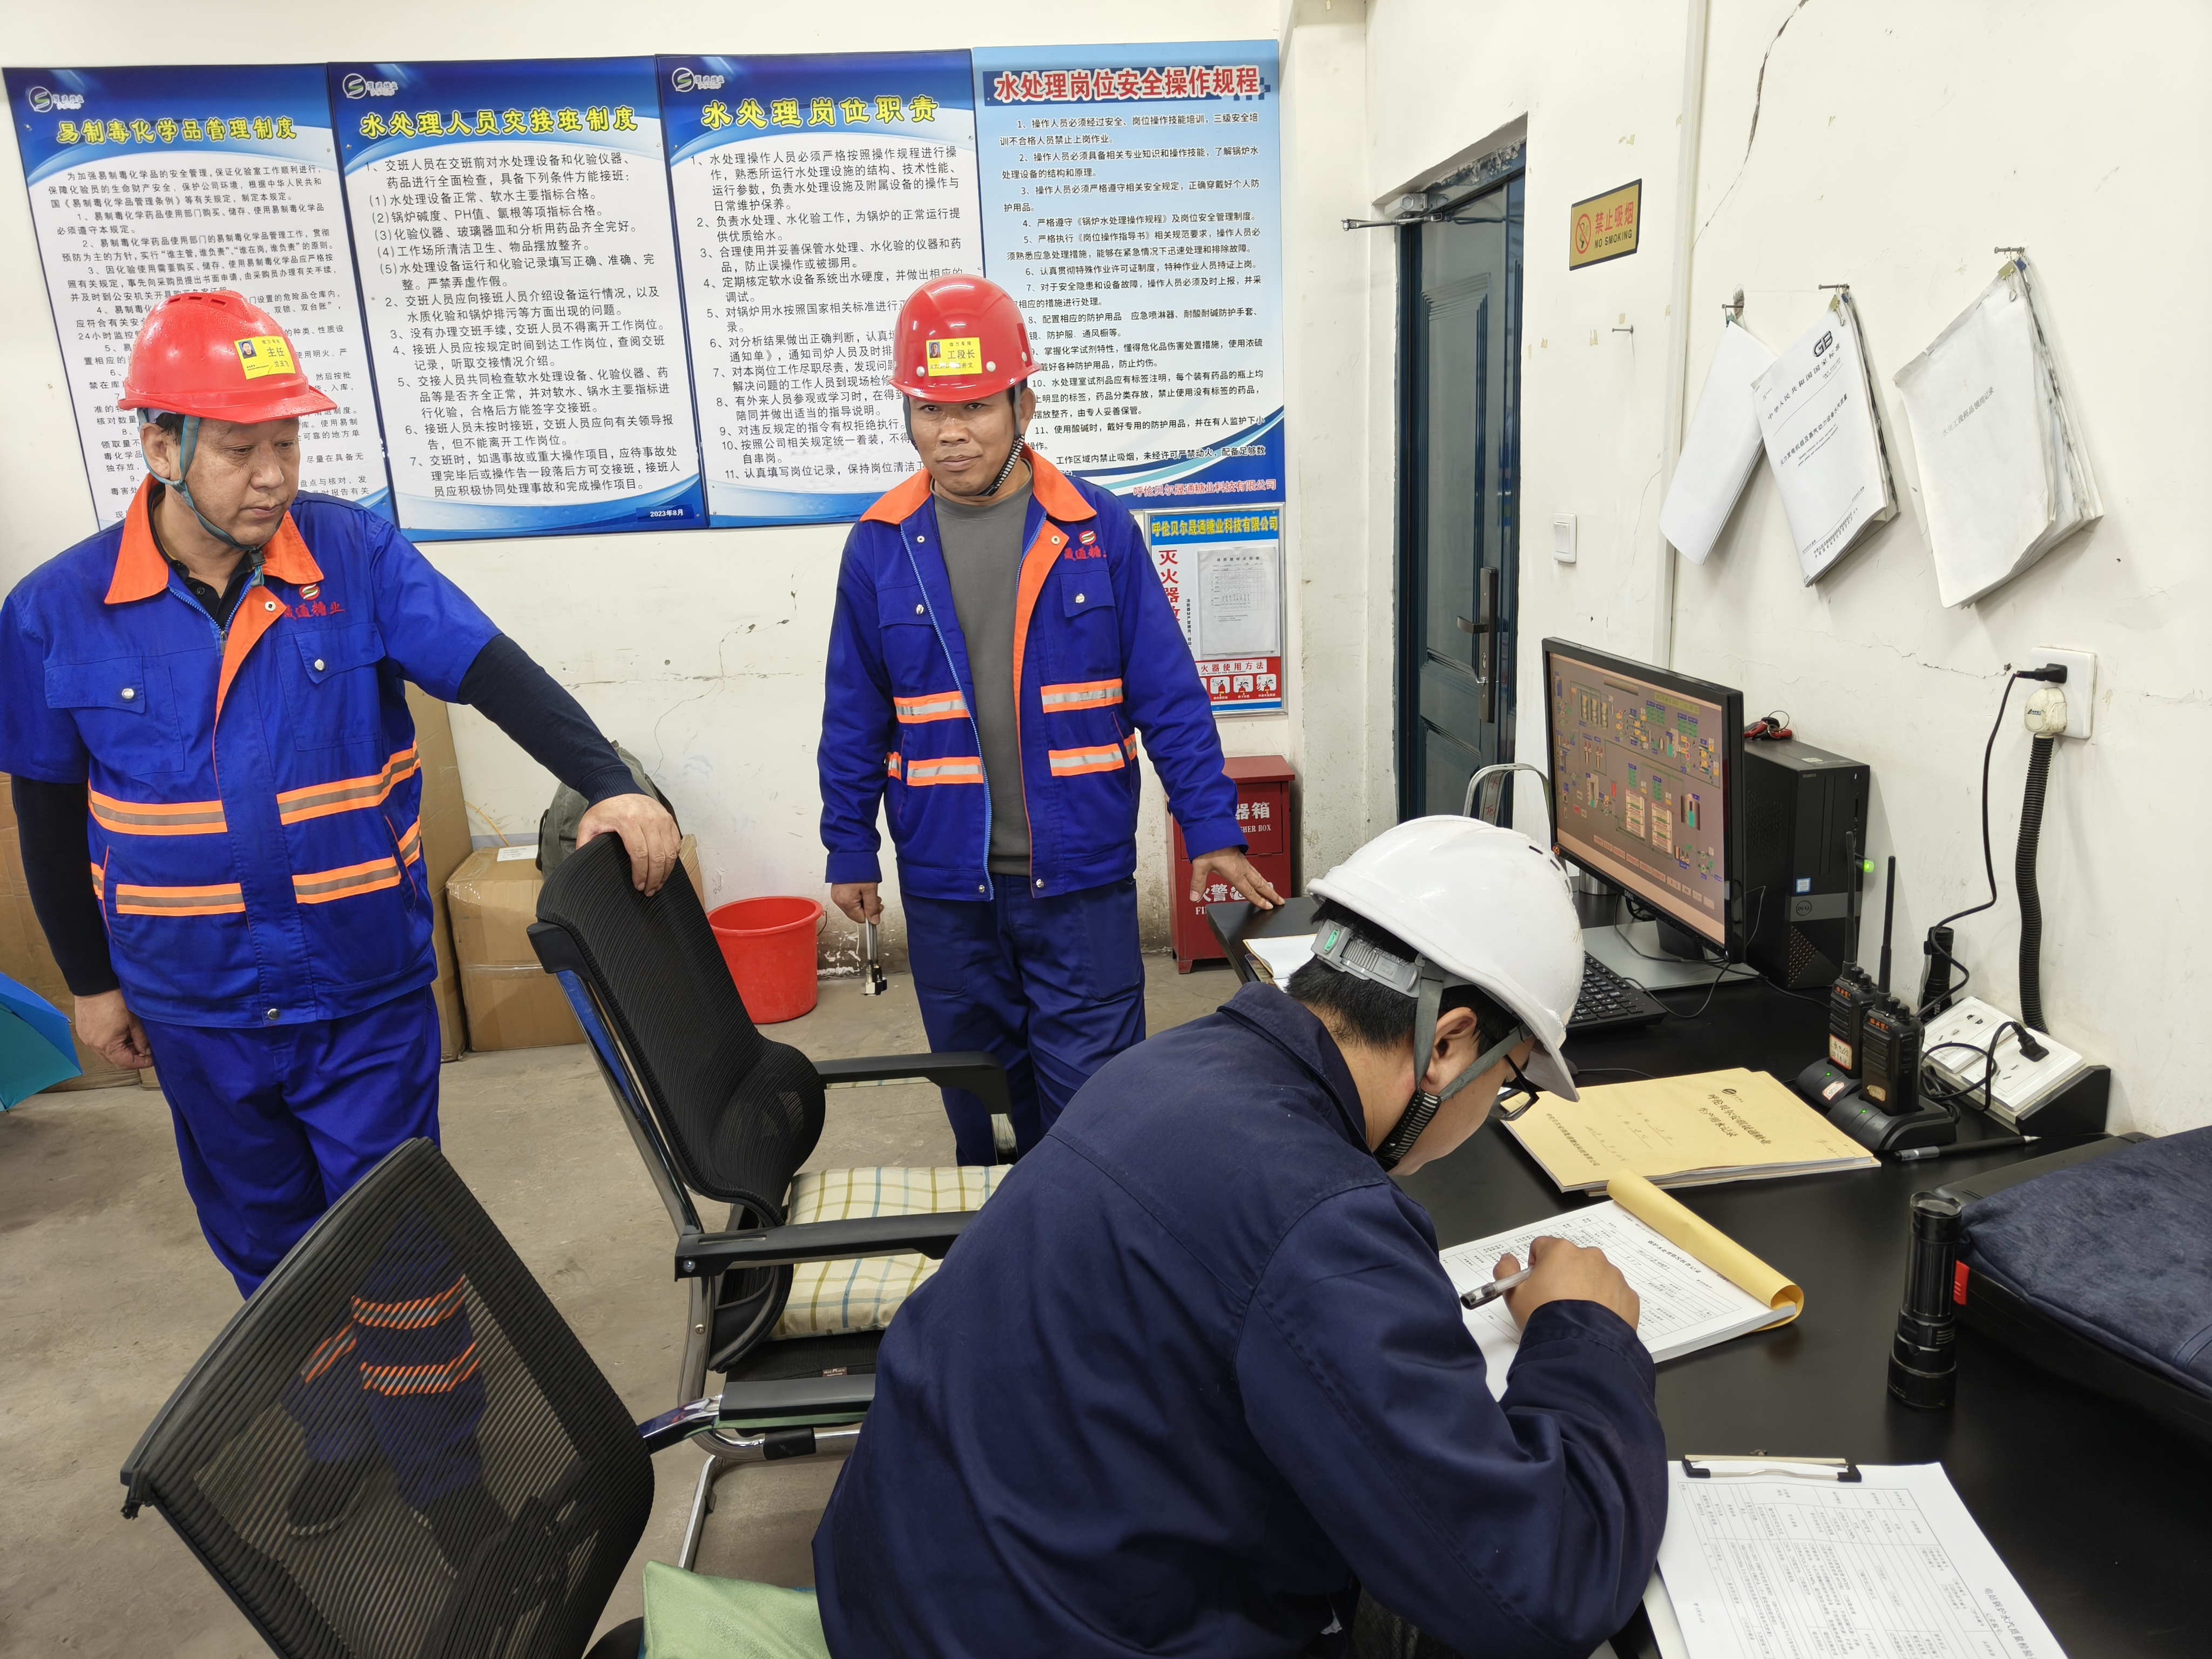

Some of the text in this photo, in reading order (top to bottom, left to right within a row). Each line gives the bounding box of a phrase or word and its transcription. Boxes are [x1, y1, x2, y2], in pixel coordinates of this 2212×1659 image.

[995, 67, 1259, 102] 水处理岗位安全操作规程
[700, 94, 939, 130] 水处理岗位职责
[360, 106, 637, 138] 水处理人员交接班制度
[57, 116, 297, 145] 易制毒化学品管理制度
[1000, 134, 1114, 146] 训不合格人员禁止上岗作业。
[1002, 167, 1096, 179] 处理设备的结构和原理。
[712, 177, 959, 196] 运行参数，负责水处理设施及附属设备的操作与
[714, 198, 791, 212] 日常维护保养。
[1003, 203, 1035, 212] 护用品。
[1595, 201, 1634, 234] 禁止吸烟
[717, 229, 783, 242] 供优质给水。
[1595, 229, 1633, 248] NO SMOKING
[721, 257, 857, 273] 品，防止误操作或被挪用。
[402, 275, 507, 291] 整。严禁弄虚作假。
[726, 291, 755, 302] 调试。
[407, 304, 621, 322] 水质化验和锅炉排污等方面出现的问题。
[727, 322, 744, 333] 录。
[267, 347, 285, 357] 主任
[1813, 331, 1833, 357] GB
[947, 349, 975, 359] 工段长
[415, 355, 554, 371] 记录，听取交接情况介绍。
[420, 382, 670, 402] 品等是否齐全正常，并对软水、锅水主要指标进
[421, 401, 597, 419] 行化验，合格后方能签字交接班。
[737, 405, 881, 421] 陪同并做出适当的指导说明。
[428, 435, 567, 450] 告，但不能离开工作岗位。
[743, 453, 782, 465] 自串岗。
[431, 461, 680, 481] 理完毕后或操作告一段落后方可交接班，接班人
[434, 478, 643, 498] 员应积极协同处理事故和完成操作项目。
[1133, 478, 1276, 498] 呼伦贝尔晟通糖业科技有限公司
[650, 509, 684, 517] 2023年8月
[1624, 888, 1634, 901] DELL
